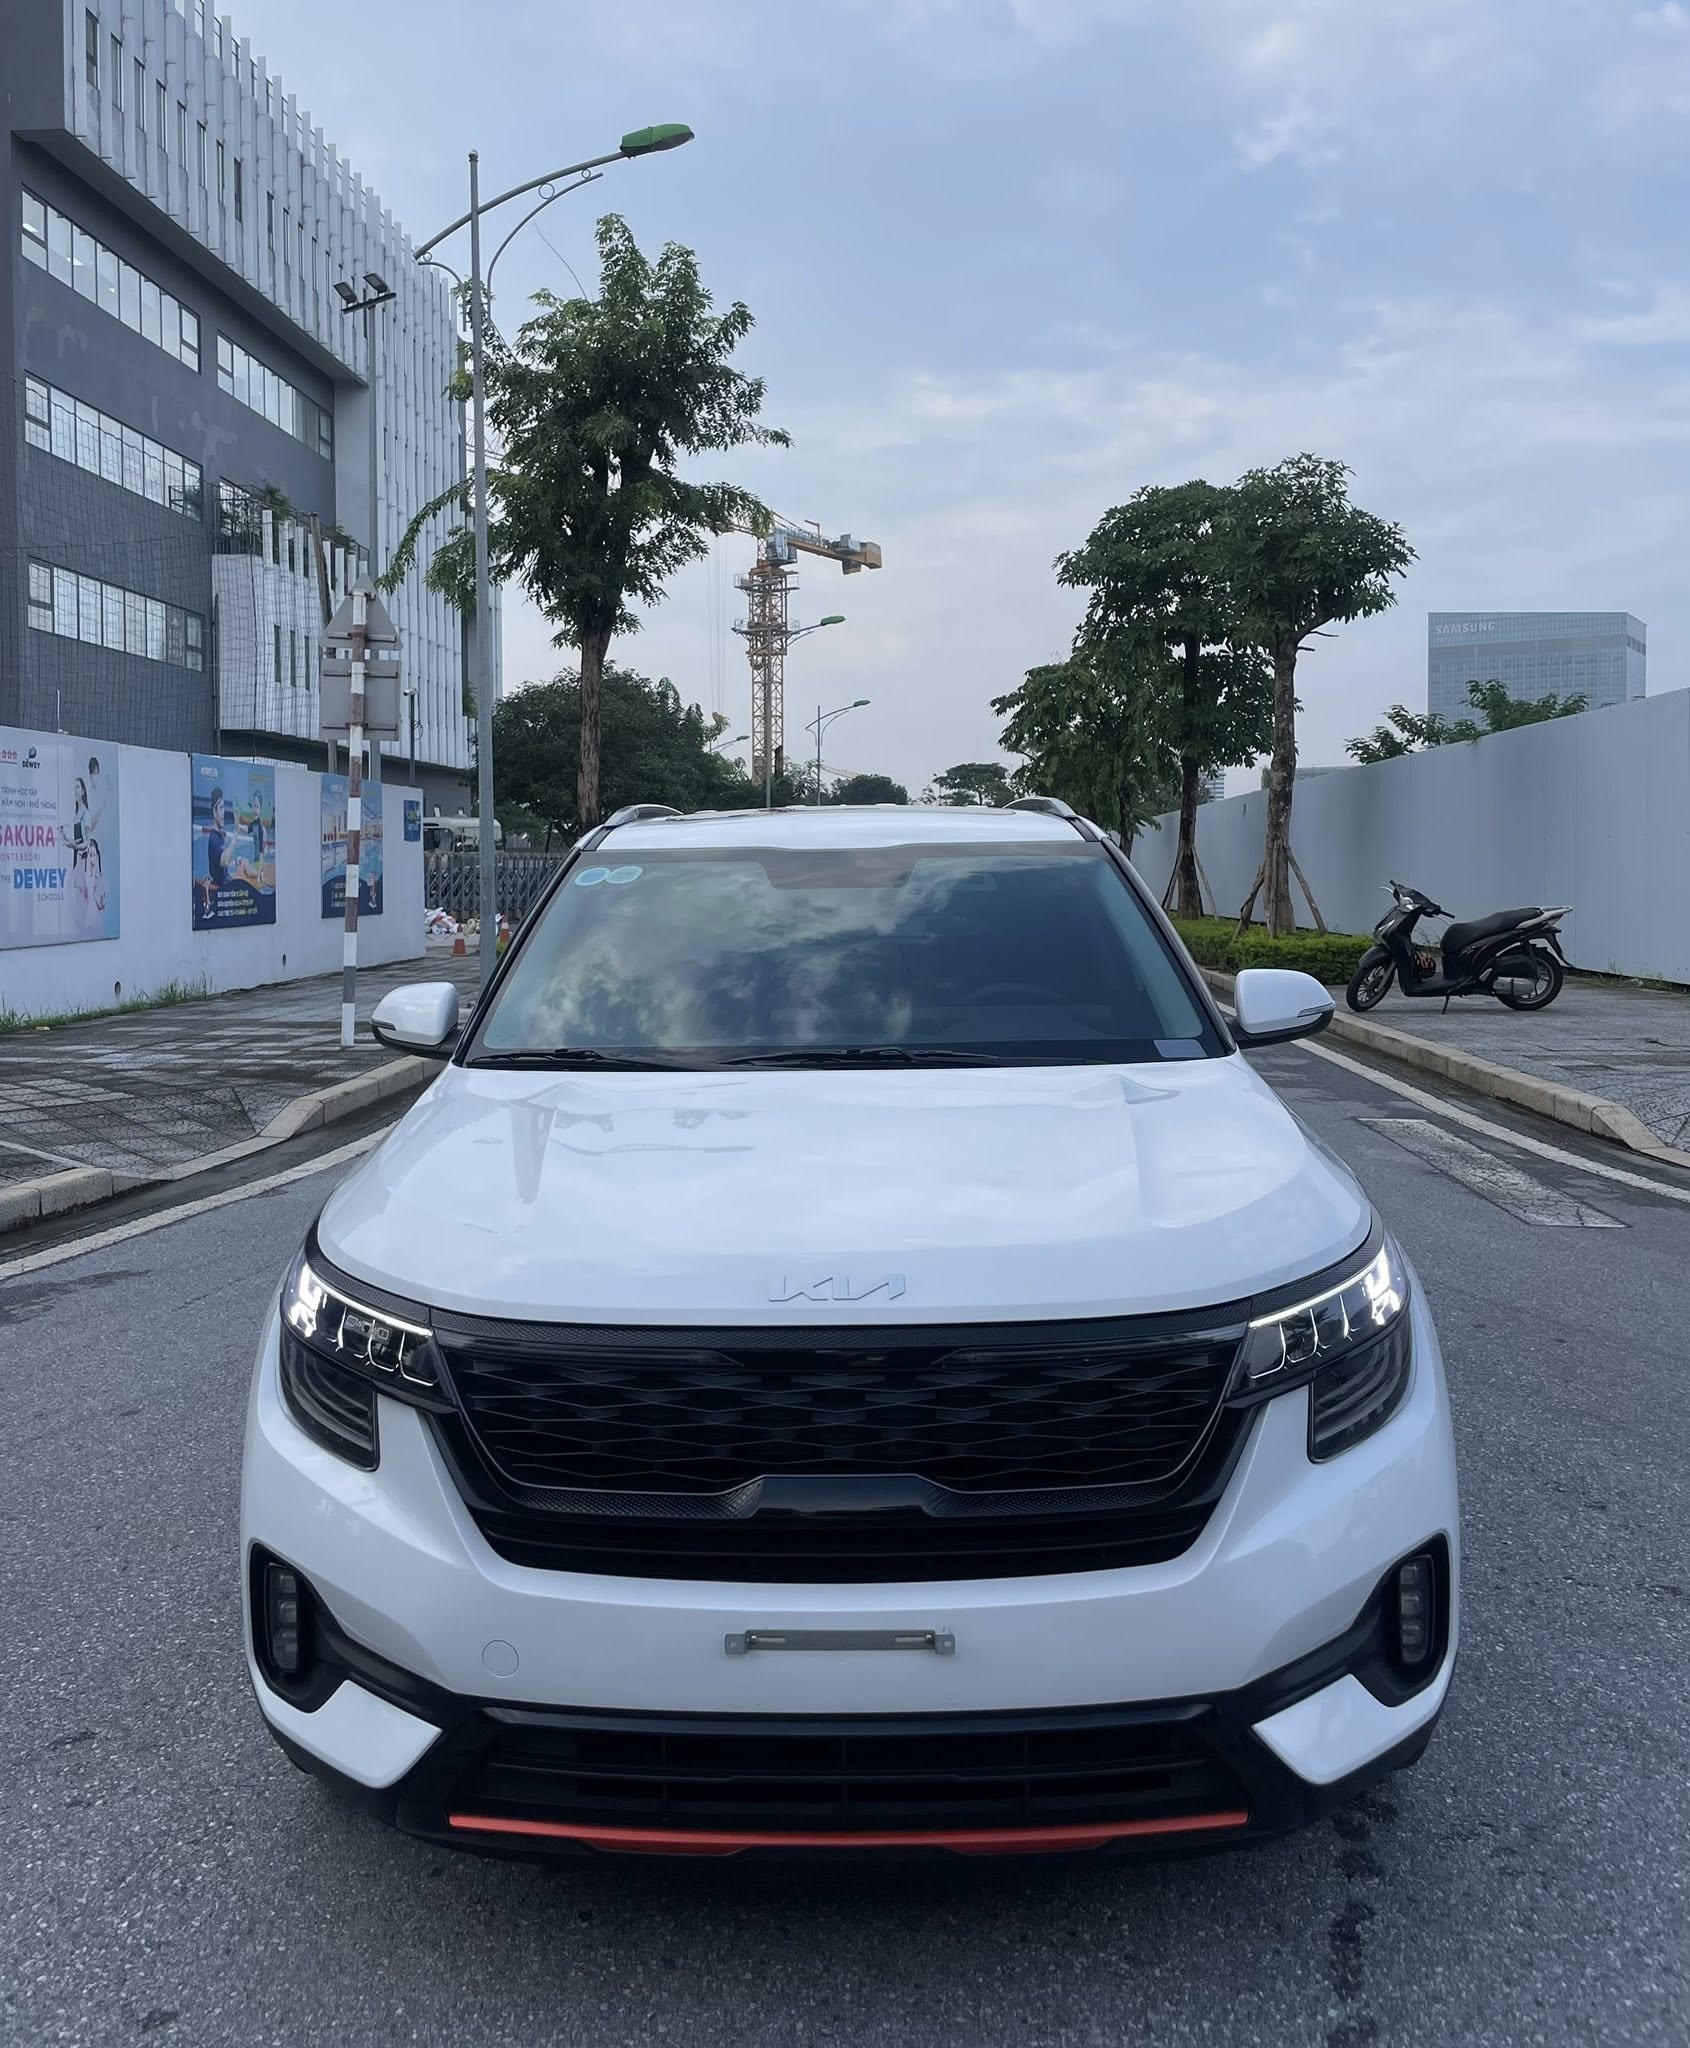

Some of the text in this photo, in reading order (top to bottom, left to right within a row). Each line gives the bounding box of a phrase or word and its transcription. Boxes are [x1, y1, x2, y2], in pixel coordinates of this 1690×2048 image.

[1435, 622, 1496, 635] SAMSUNG
[0, 824, 55, 848] AKURA
[1, 868, 67, 890] THE DEWEY
[768, 1275, 905, 1302] KIA
